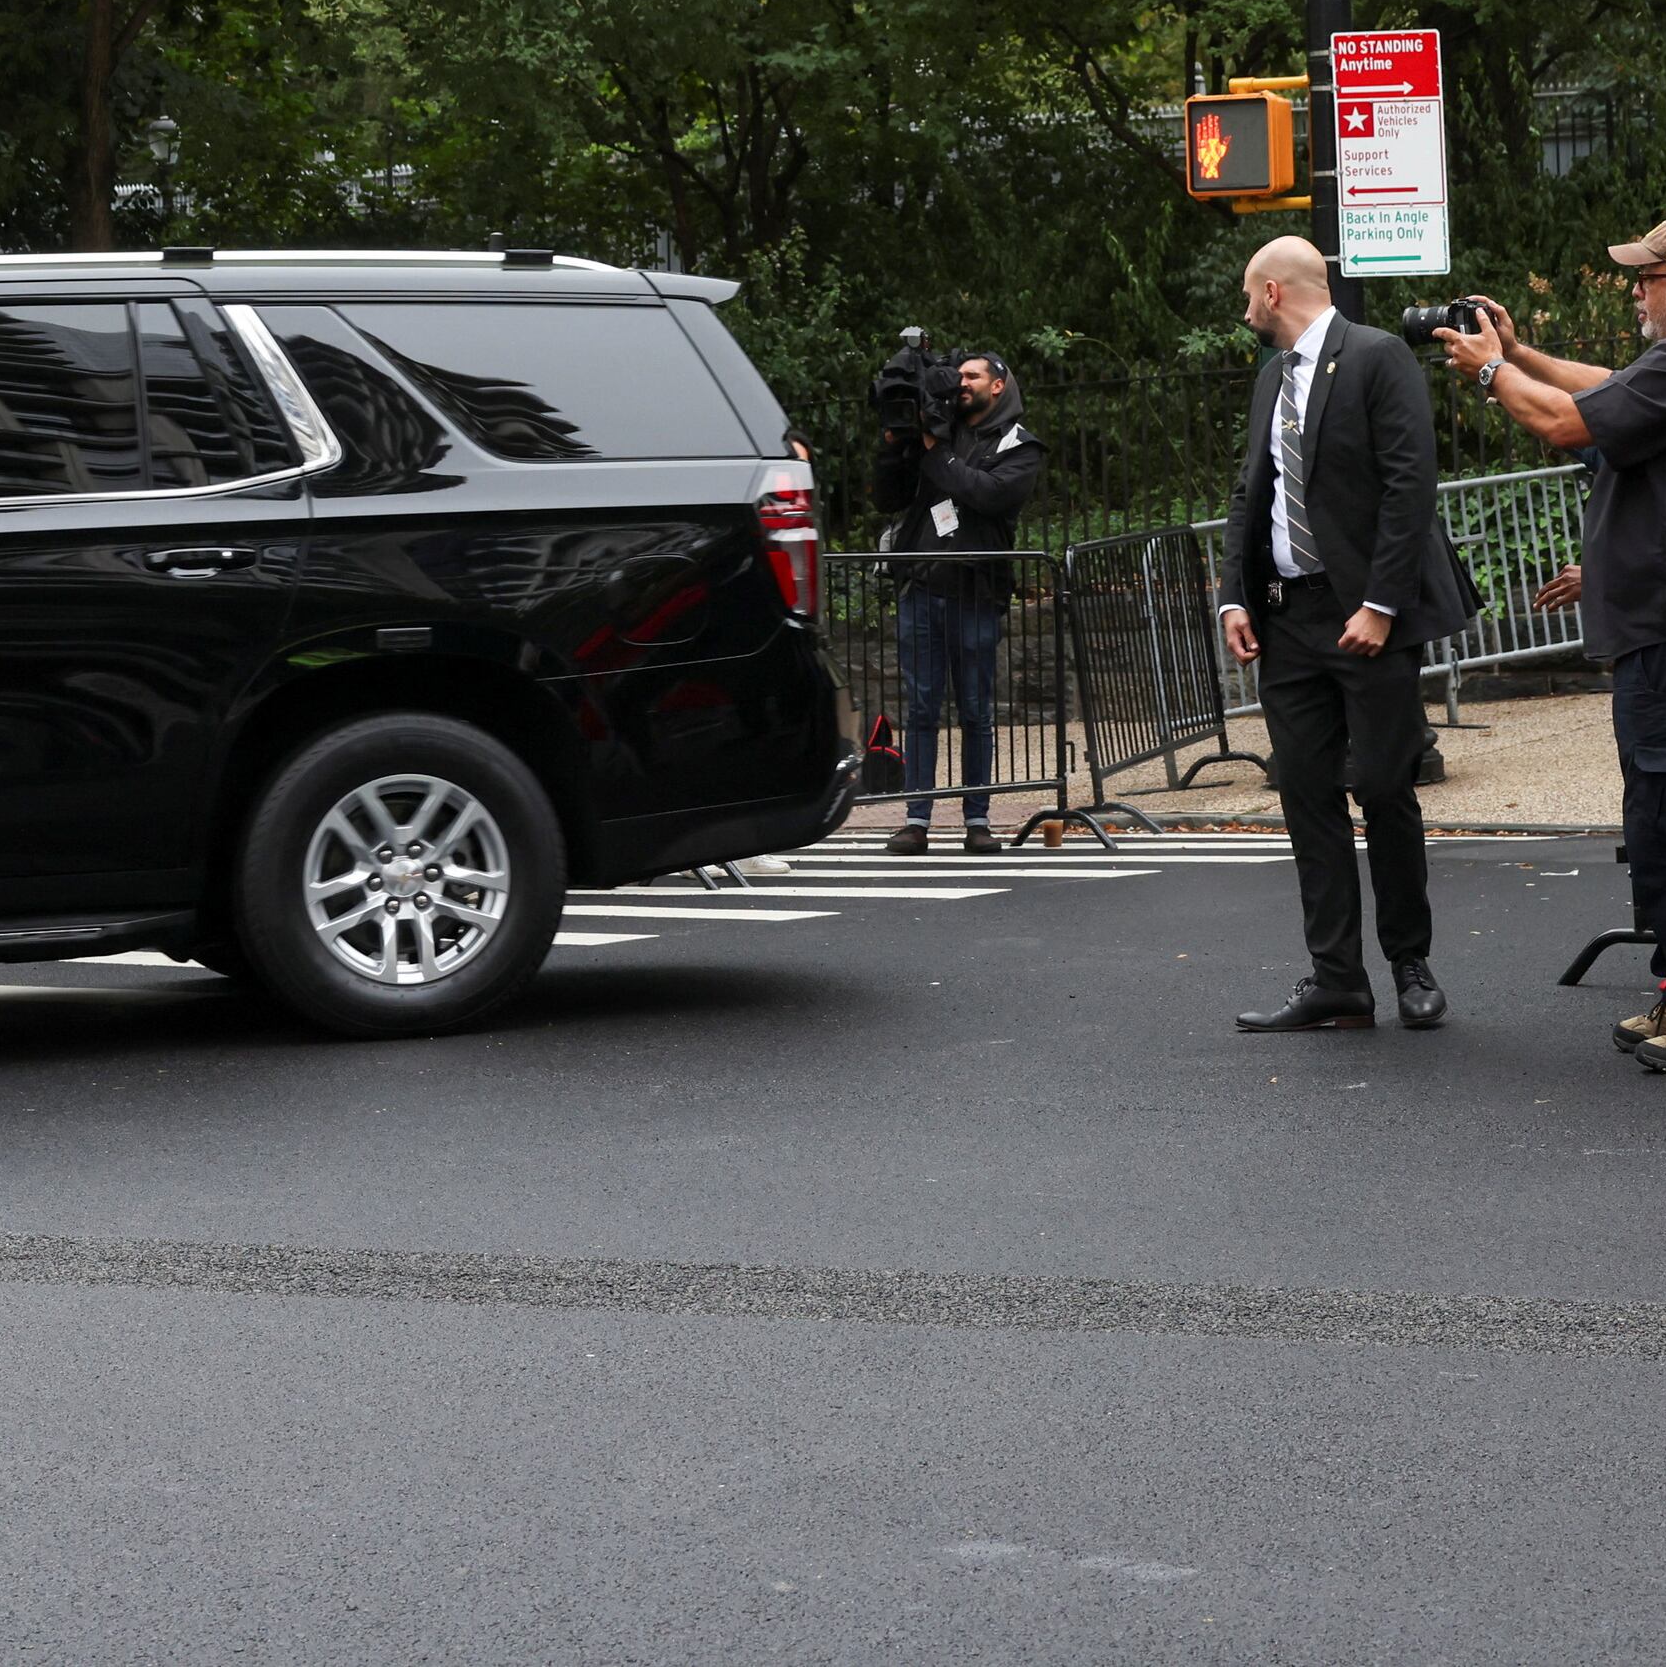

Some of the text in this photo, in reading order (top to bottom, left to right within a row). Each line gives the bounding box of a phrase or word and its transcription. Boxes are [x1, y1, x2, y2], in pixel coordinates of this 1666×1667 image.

[1338, 39, 1423, 55] NO STANDING
[1340, 57, 1393, 74] Anytime
[1377, 104, 1431, 114] Authorized
[1378, 116, 1418, 126] Vehicles
[1378, 128, 1400, 139] Only
[1344, 149, 1389, 162] Support
[1344, 165, 1393, 177] Services
[1346, 211, 1429, 226] Back In Angle
[1347, 227, 1424, 242] Parking Only
